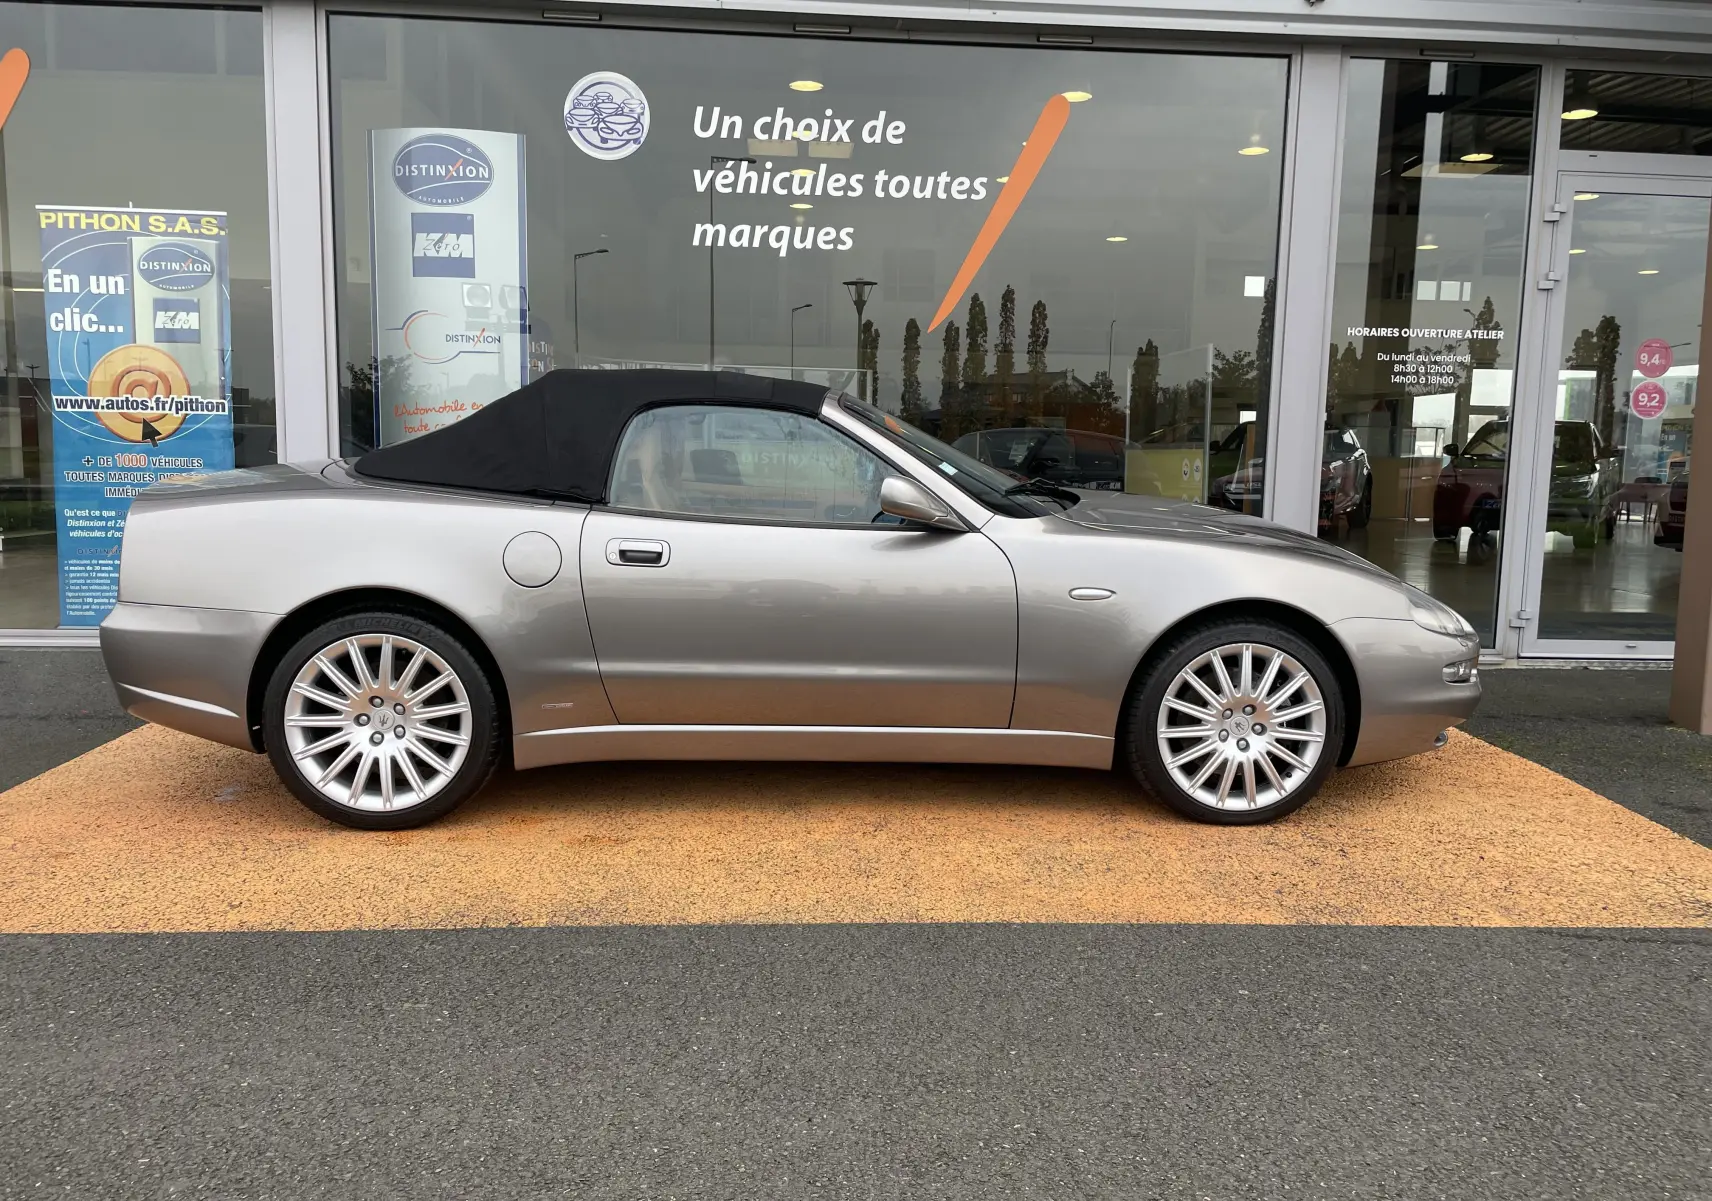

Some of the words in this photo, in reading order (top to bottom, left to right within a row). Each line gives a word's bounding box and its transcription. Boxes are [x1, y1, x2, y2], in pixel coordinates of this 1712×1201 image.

[692, 106, 743, 140] Un
[753, 107, 854, 143] choix
[861, 111, 906, 145] de
[395, 163, 489, 178] DISTINXION
[692, 161, 864, 198] véhicules
[874, 170, 988, 201] toutes
[39, 212, 141, 232] PITHON
[148, 215, 226, 236] S.A.S.
[692, 223, 854, 257] marques
[139, 261, 211, 272] DISTINXION
[48, 269, 80, 293] En
[89, 274, 125, 295] un
[50, 307, 124, 332] clic...
[445, 333, 501, 344] DISTINXION
[1347, 327, 1399, 337] HORAIRES
[1401, 328, 1462, 339] OUVERTURE
[1464, 330, 1504, 340] ATELIER
[1377, 353, 1390, 361] Du
[1391, 353, 1415, 362] lundi
[1417, 354, 1429, 362] au
[1430, 354, 1471, 363] vendredi
[1640, 353, 1660, 367] 9,4
[1393, 365, 1417, 373] 8h30
[1418, 364, 1426, 373] à
[1427, 365, 1453, 373] 12h00
[1391, 375, 1418, 384] 14h00
[1419, 375, 1426, 384] à
[1428, 376, 1454, 384] 18h00
[55, 396, 226, 415] www.autos.fr/pithon
[1638, 393, 1660, 407] 9,2
[404, 420, 431, 434] toute
[98, 456, 112, 466] DE
[115, 453, 147, 468] 1000
[150, 455, 204, 468] VÉHICULES
[64, 471, 105, 482] TOUTES
[108, 472, 155, 482] MARQUES
[67, 519, 106, 527] Distinxion
[69, 530, 106, 538] véhicules
